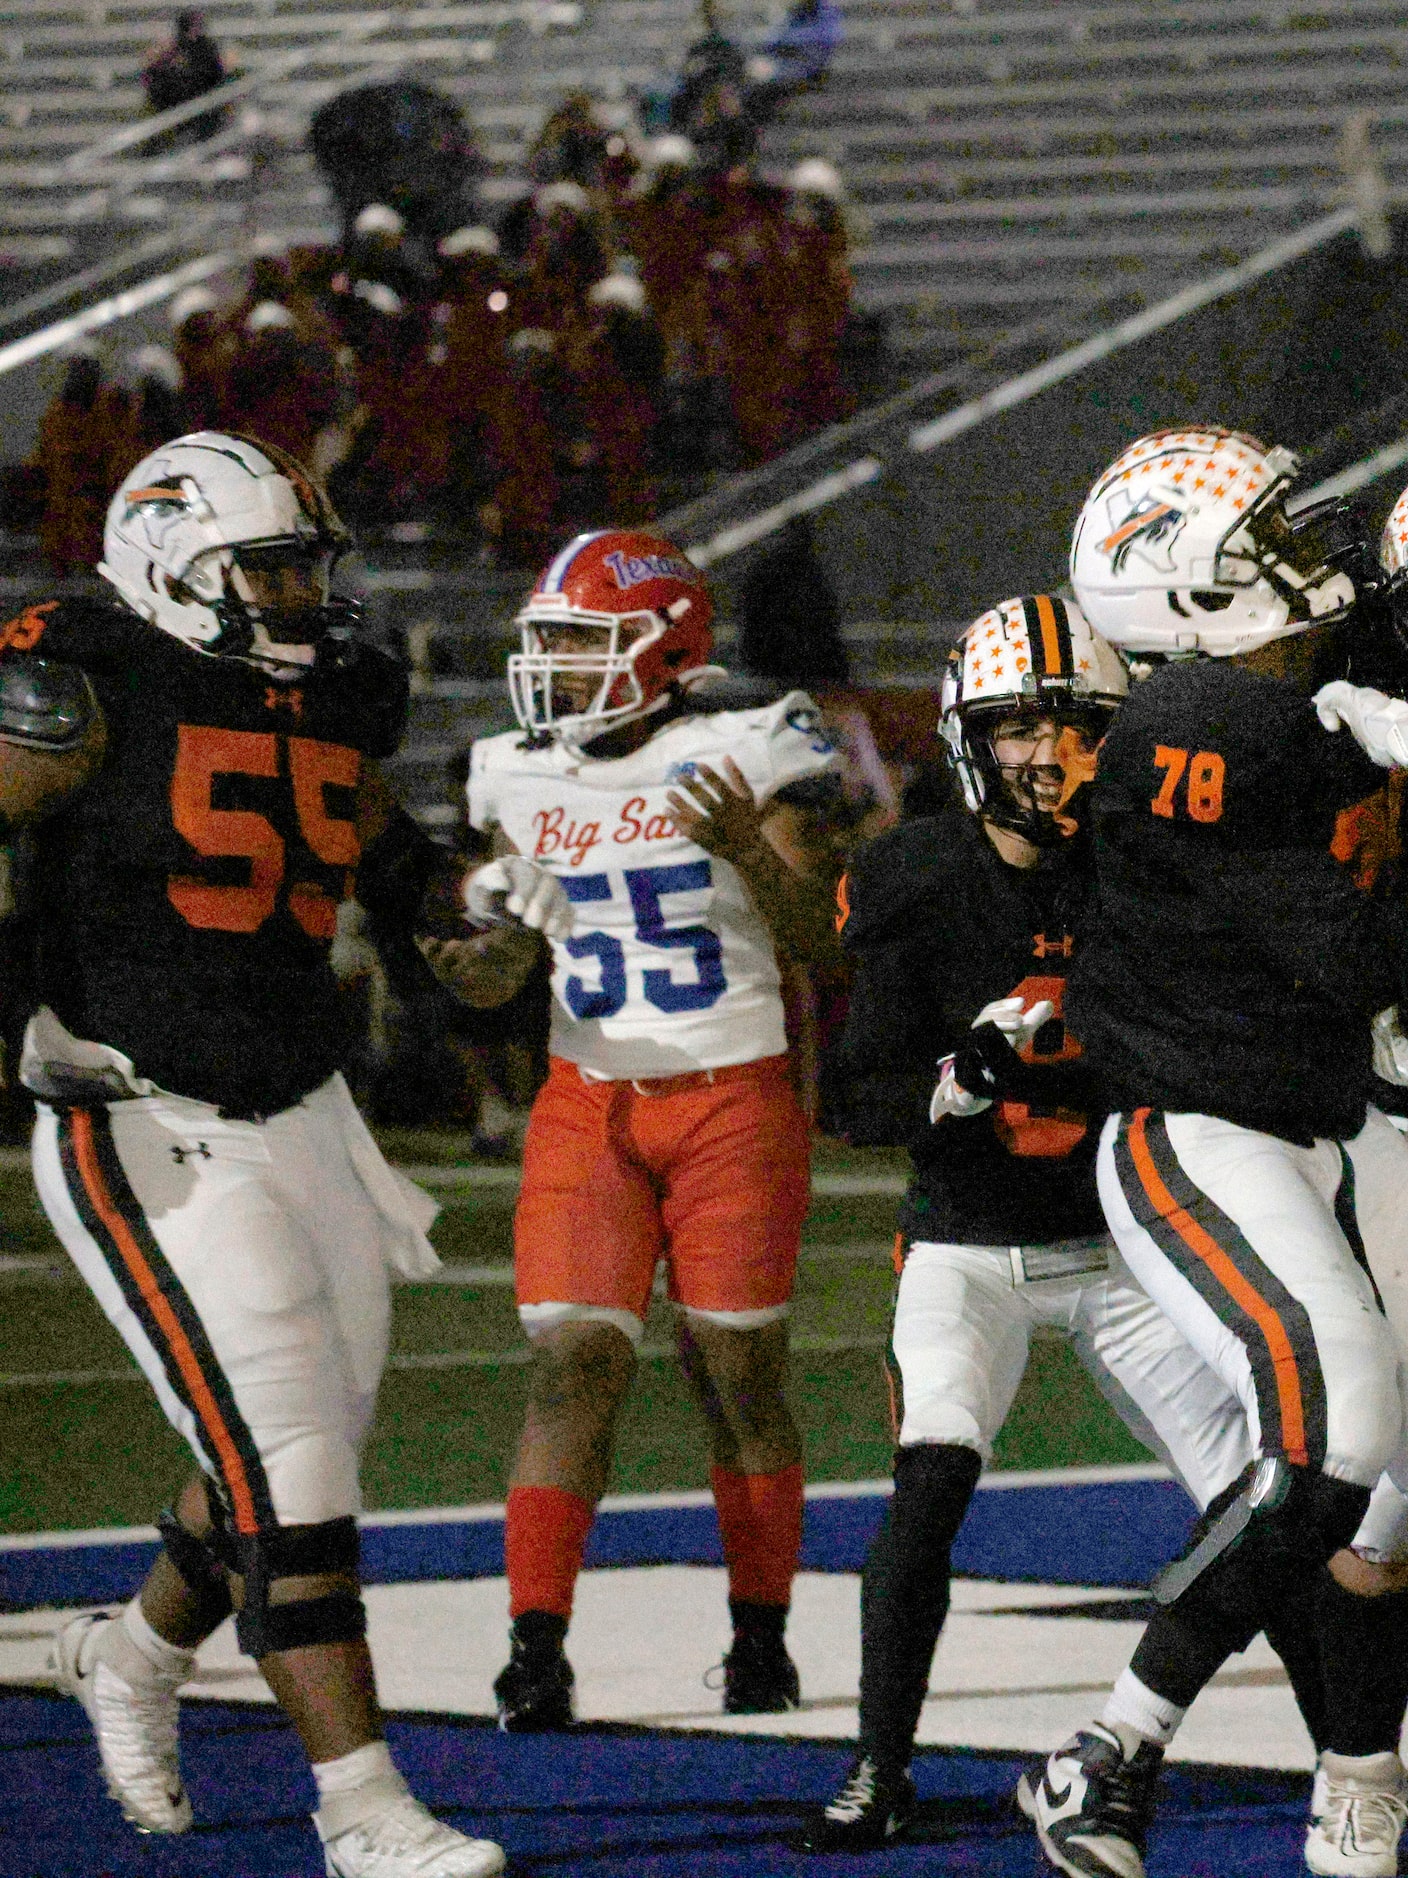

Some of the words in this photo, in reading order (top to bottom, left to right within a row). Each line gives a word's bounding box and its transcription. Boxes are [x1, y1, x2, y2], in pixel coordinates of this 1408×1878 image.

[167, 724, 362, 940] 55
[532, 806, 602, 867] Big
[612, 796, 682, 844] Sa
[1153, 744, 1226, 824] 78
[553, 858, 728, 1022] 55
